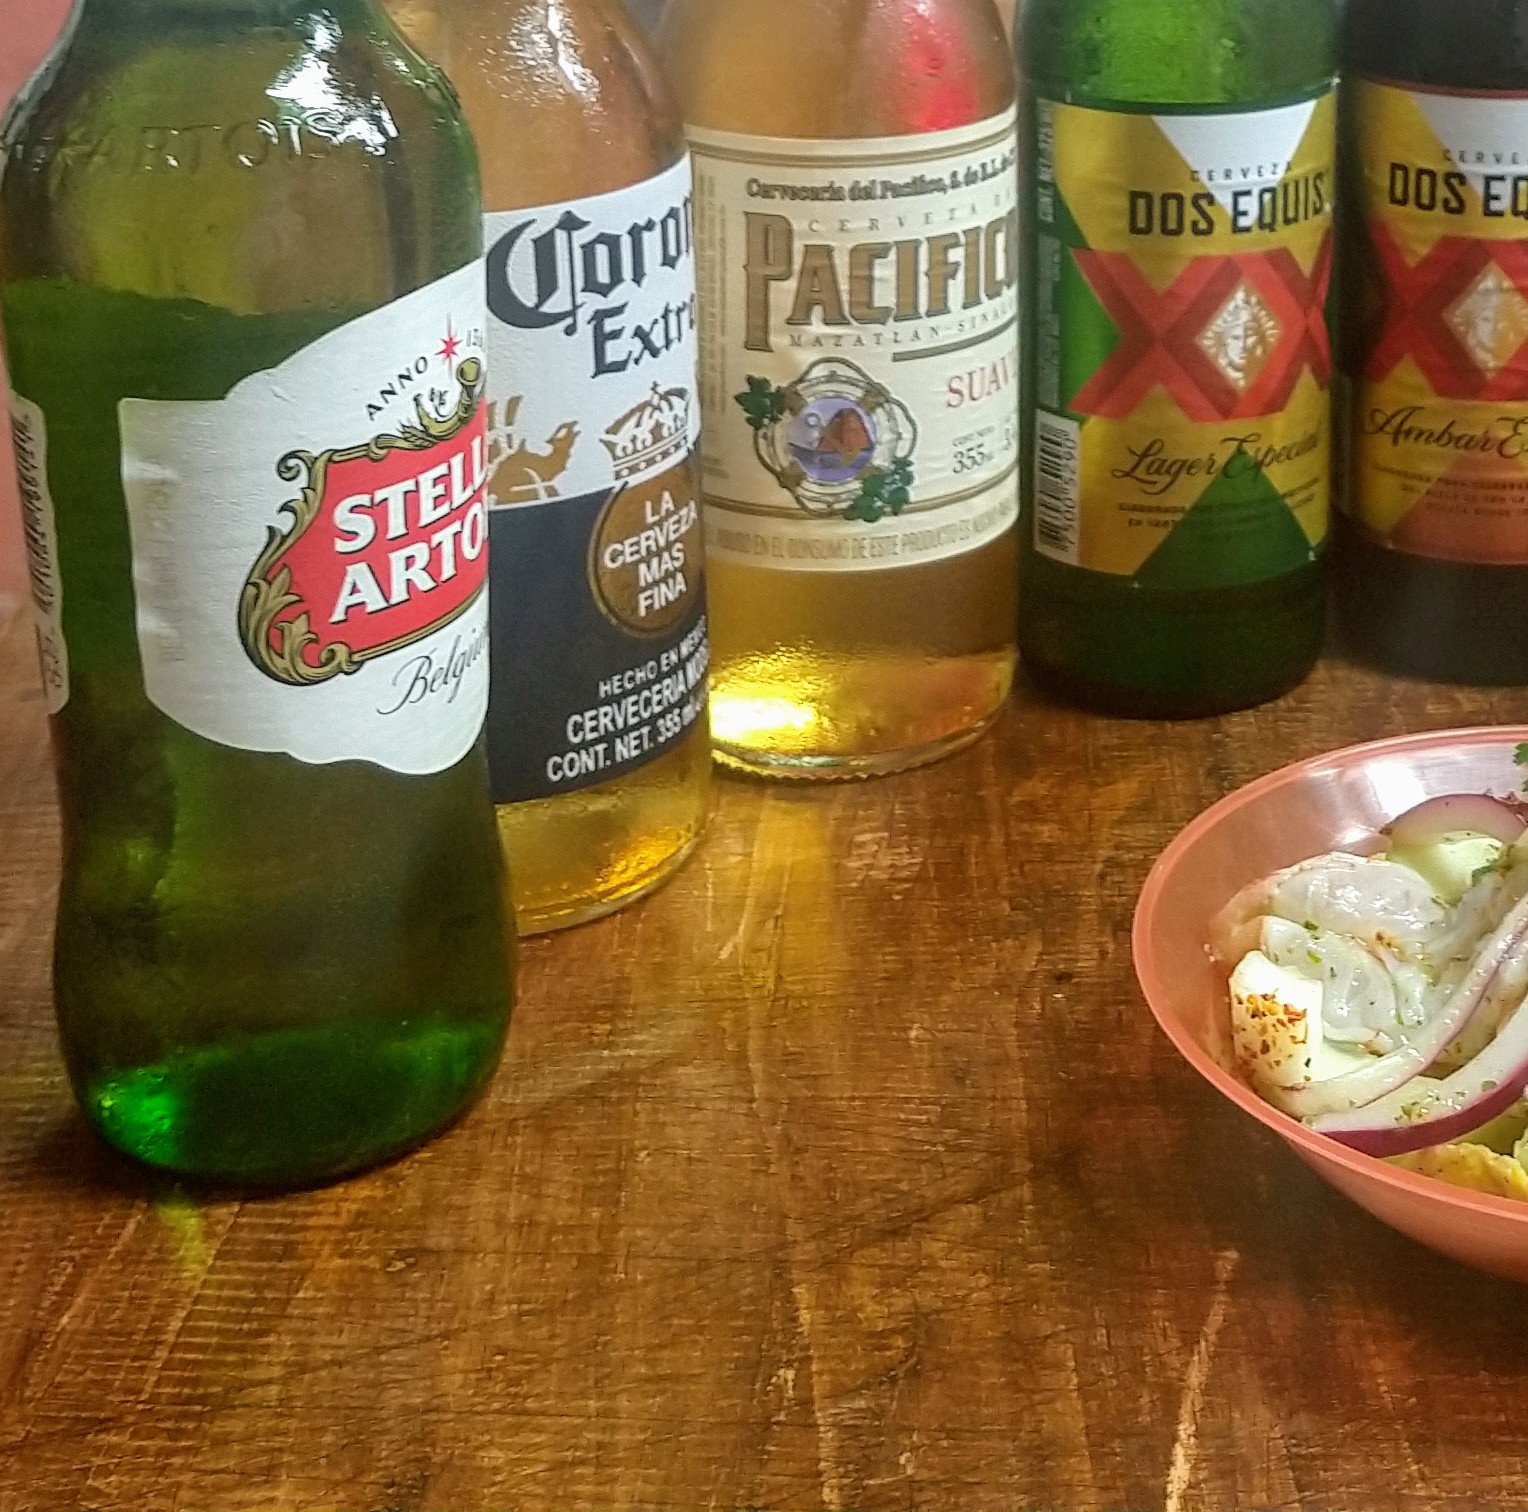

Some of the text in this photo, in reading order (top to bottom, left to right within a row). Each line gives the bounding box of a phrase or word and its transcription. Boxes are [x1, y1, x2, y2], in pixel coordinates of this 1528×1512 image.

[1190, 160, 1294, 183] CERVEZA
[1389, 162, 1467, 215] DOS
[1128, 171, 1326, 236] DOS EQUIS
[587, 291, 695, 379] Extr
[366, 356, 428, 421] ANNO
[1363, 405, 1497, 453] Ambar
[953, 442, 985, 474] 355
[1111, 438, 1216, 495] Lager
[1219, 430, 1322, 480] Especial
[333, 435, 487, 554] STELL
[644, 490, 675, 524] LA
[603, 498, 698, 570] CERVEZA
[637, 542, 685, 588] MAS
[636, 572, 687, 617] FINA
[599, 659, 658, 700] HECHO
[659, 646, 679, 672] EN
[546, 742, 612, 782] CONT.
[614, 724, 655, 763] NET.
[656, 707, 682, 744] 355
